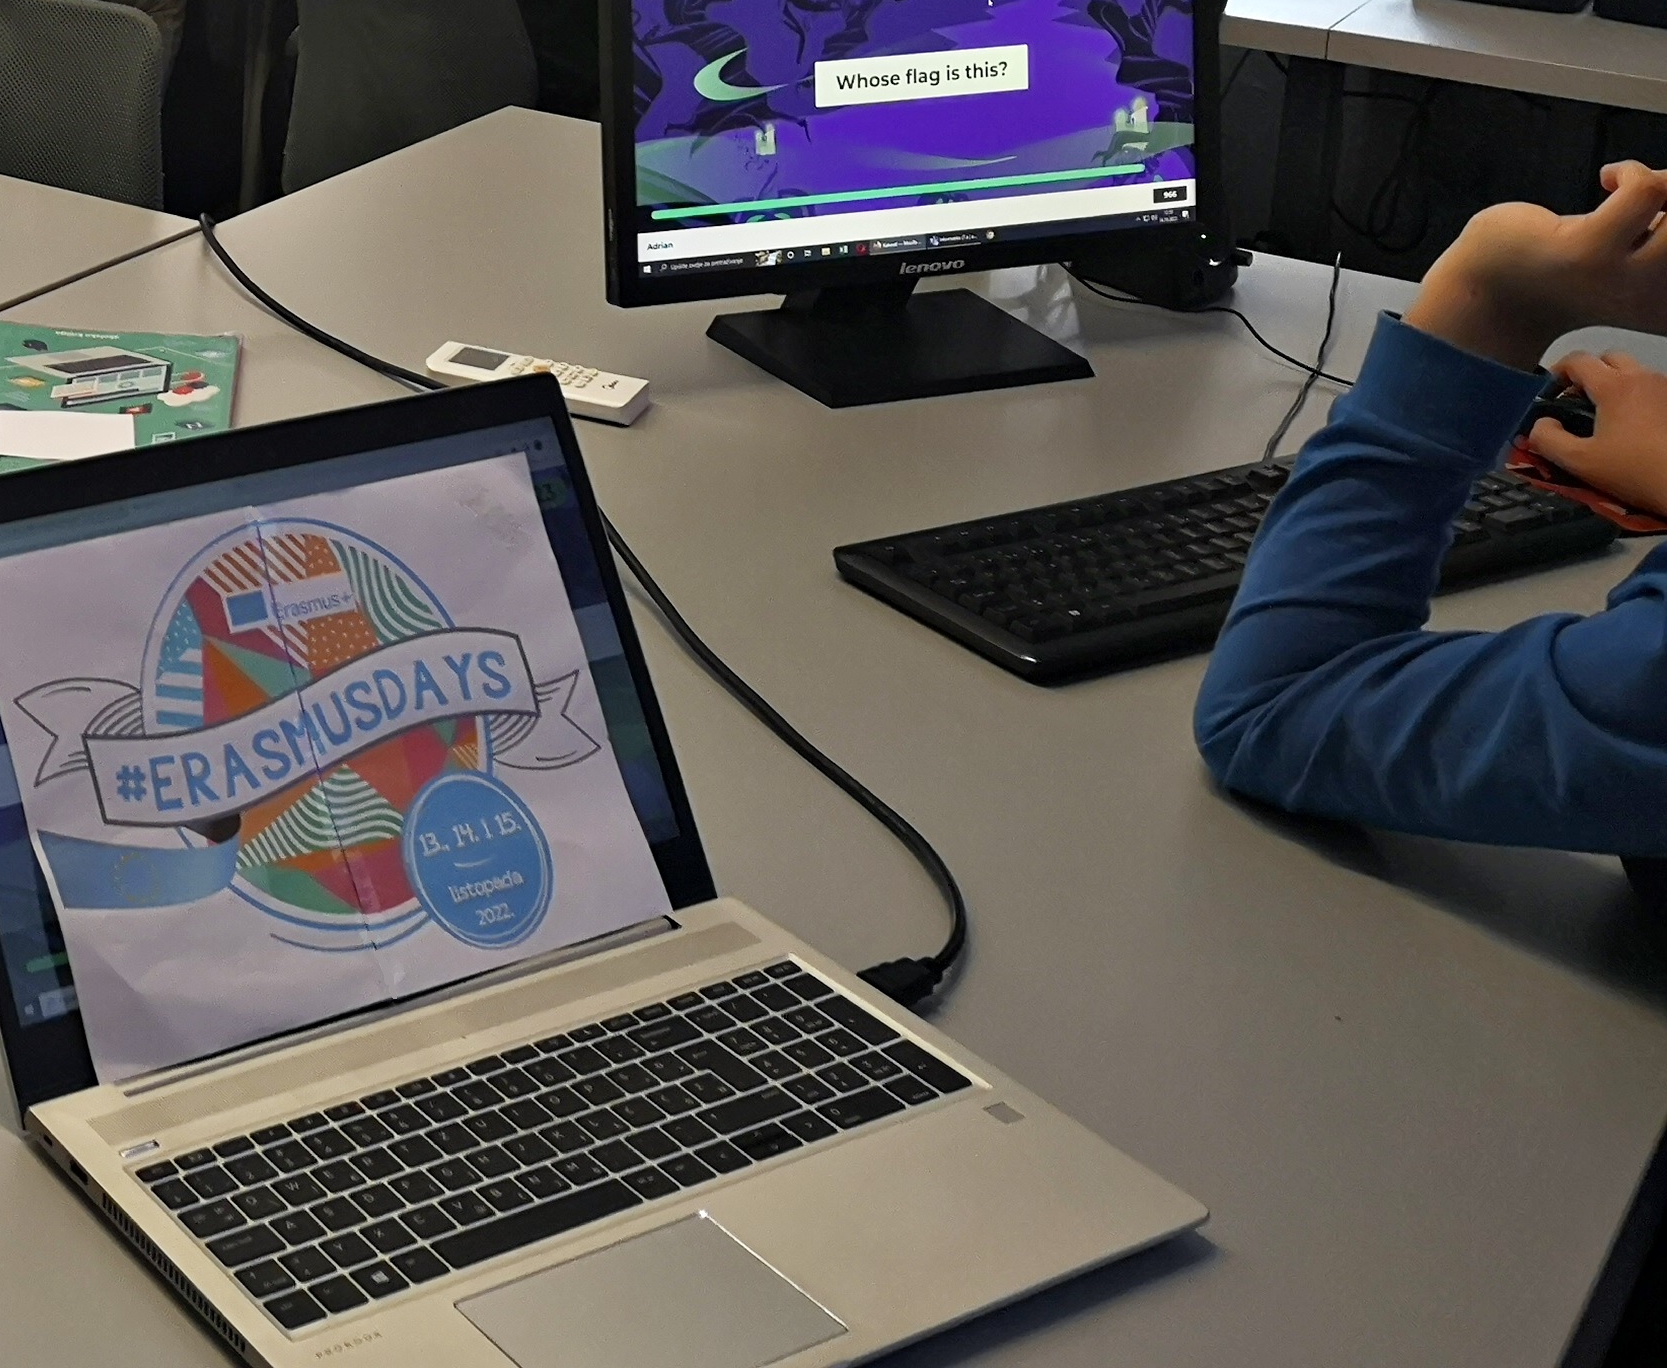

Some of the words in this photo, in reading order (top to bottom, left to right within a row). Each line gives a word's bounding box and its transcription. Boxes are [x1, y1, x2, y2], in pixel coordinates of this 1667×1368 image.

[836, 73, 901, 90] Whose
[905, 68, 940, 86] flag
[946, 65, 960, 81] is
[965, 61, 1008, 79] this?
[1163, 190, 1178, 199] 966
[647, 241, 674, 250] Adrian
[899, 259, 965, 274] lenovo
[115, 650, 513, 812] #ERASMUSDAYS
[452, 823, 480, 848] 14.
[494, 811, 522, 836] 15.
[448, 870, 525, 904] listopada
[475, 903, 516, 926] 2022.
